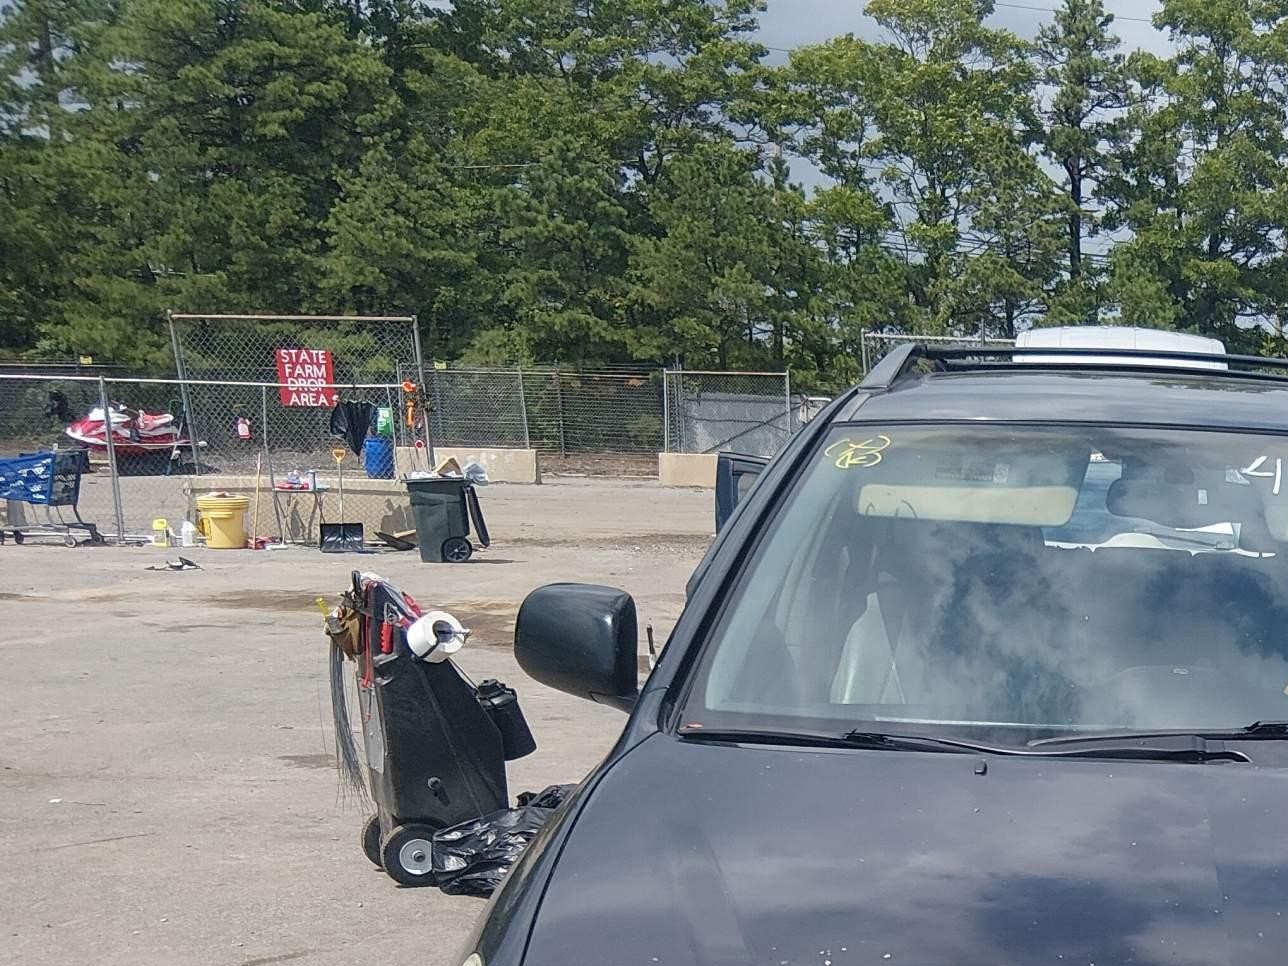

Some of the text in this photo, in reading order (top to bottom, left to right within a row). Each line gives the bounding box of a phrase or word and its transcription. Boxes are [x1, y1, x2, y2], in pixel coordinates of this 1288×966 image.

[280, 349, 327, 363] STATE
[284, 364, 327, 378] FARM
[287, 378, 326, 391] DROP
[289, 392, 330, 406] AREA
